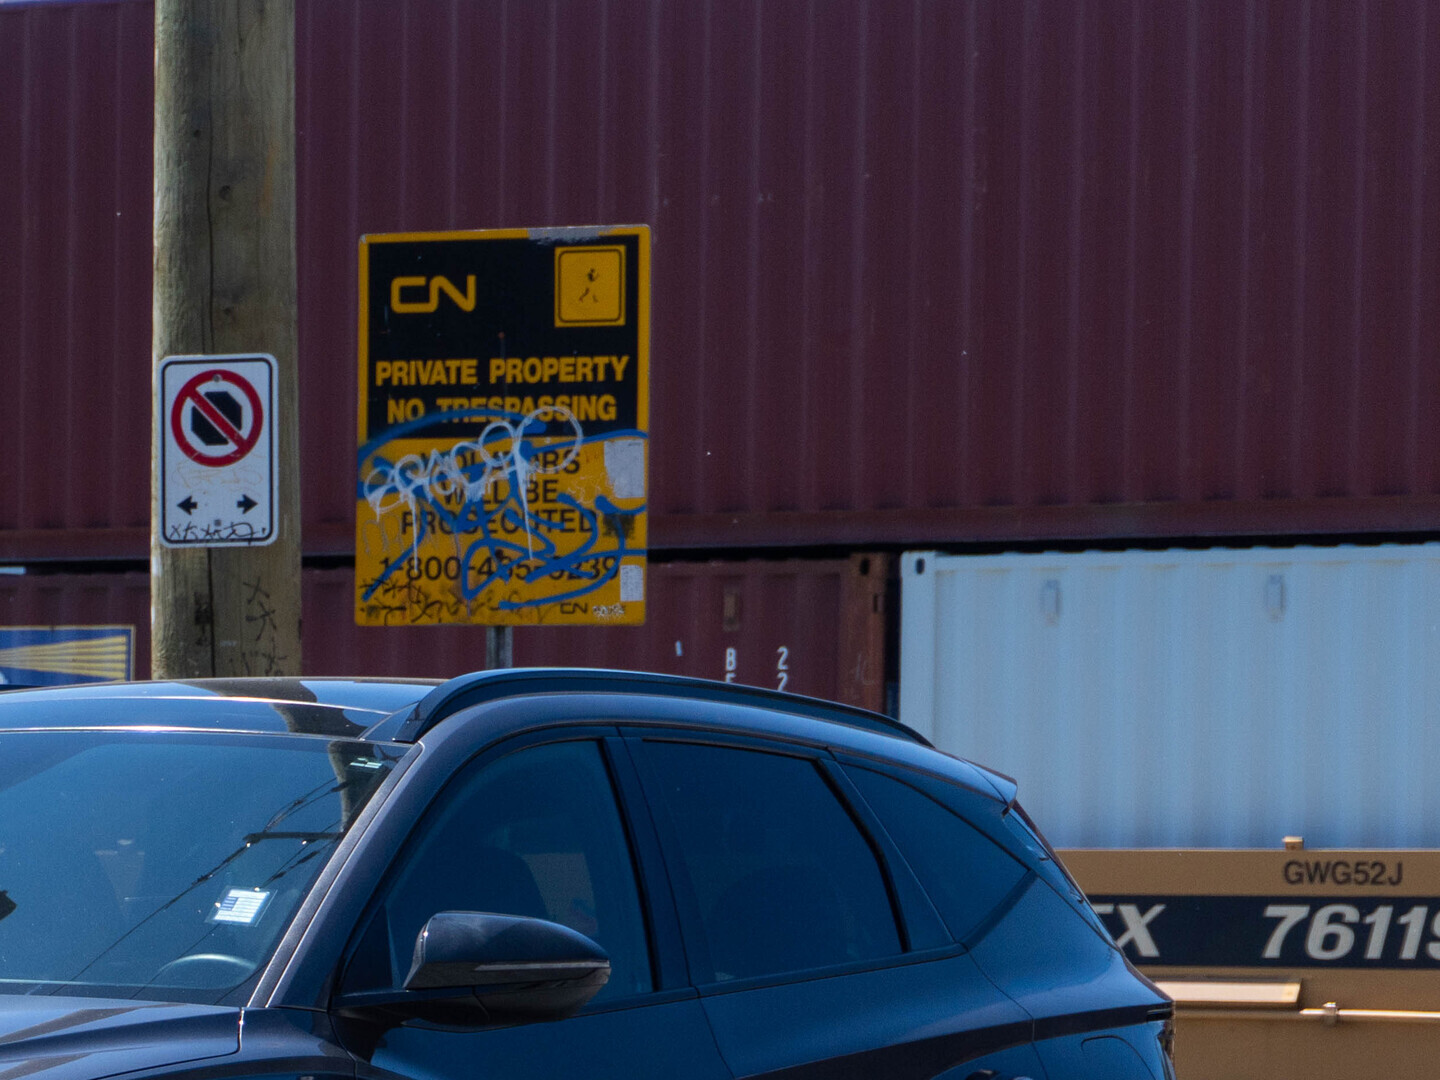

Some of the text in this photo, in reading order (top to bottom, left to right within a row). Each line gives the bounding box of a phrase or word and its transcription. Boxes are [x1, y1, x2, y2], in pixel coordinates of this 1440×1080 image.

[391, 274, 476, 313] CN
[375, 355, 630, 387] PRIVATE PROPERTY
[387, 394, 617, 424] NO TRESPASSING
[560, 601, 589, 615] CN
[1283, 860, 1404, 887] GWG52J
